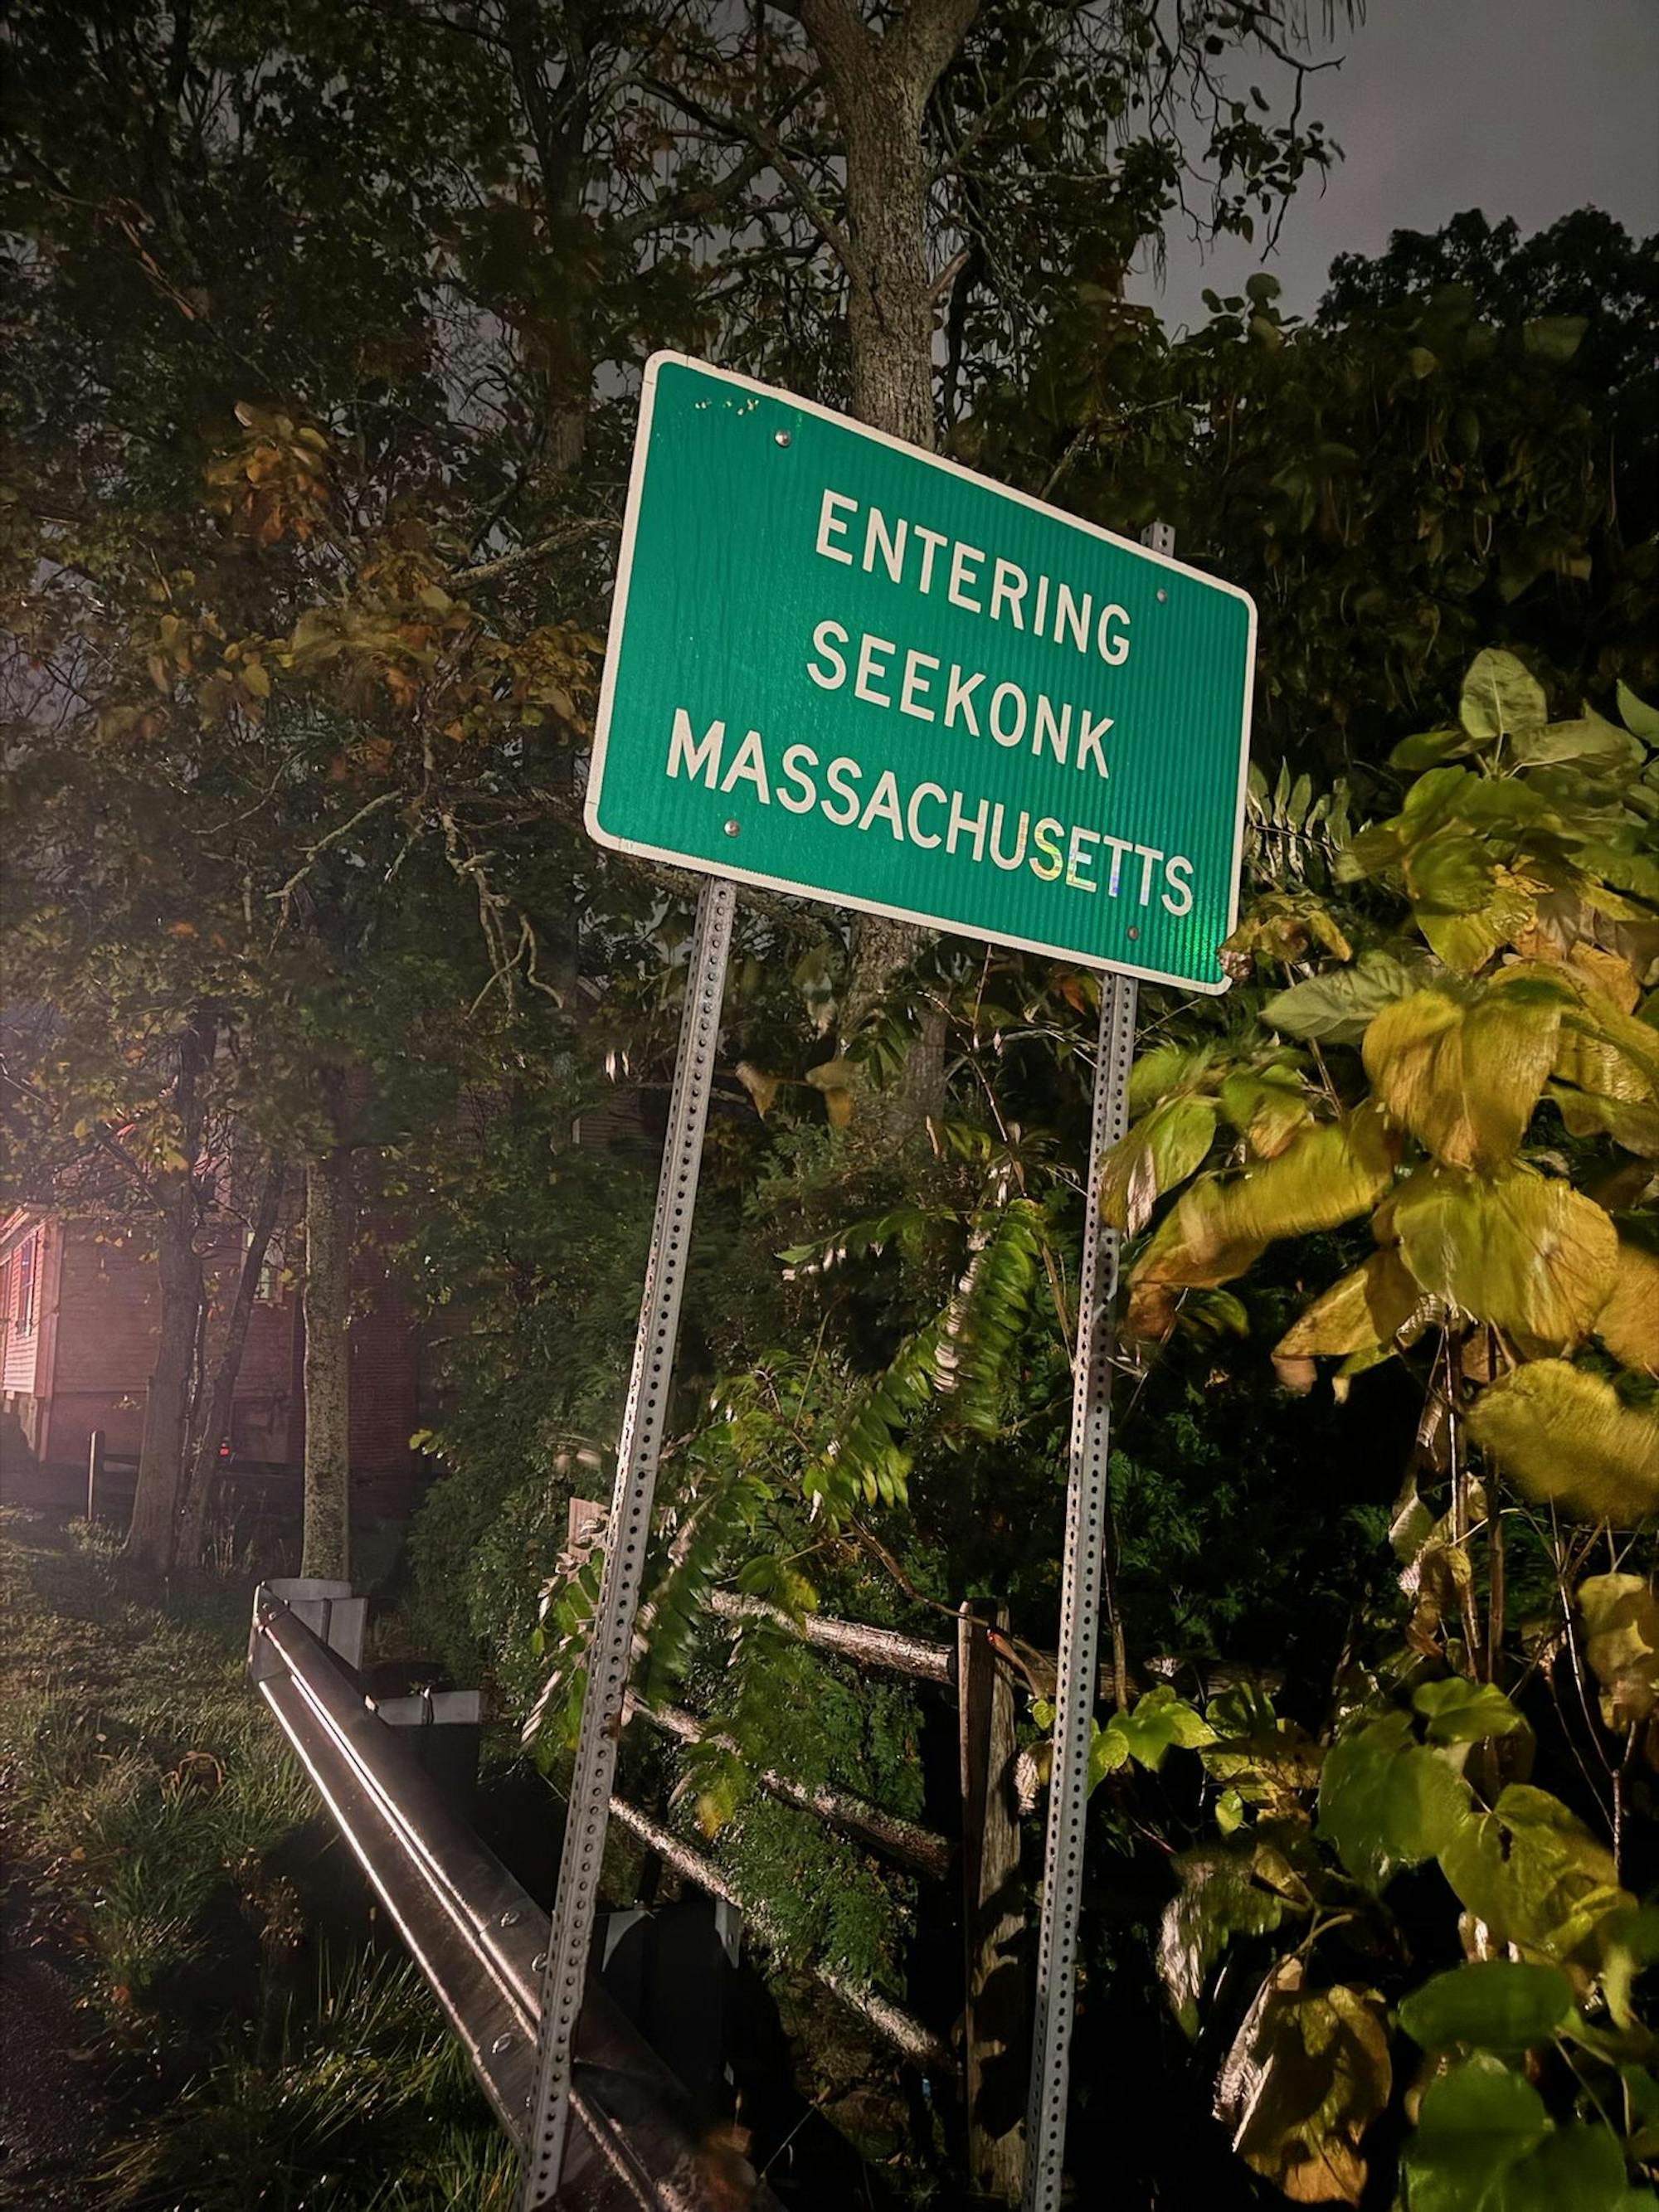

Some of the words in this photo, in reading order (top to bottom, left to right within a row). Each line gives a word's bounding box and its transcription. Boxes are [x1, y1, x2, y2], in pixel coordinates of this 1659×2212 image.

[816, 489, 1131, 665] ENTERING
[806, 620, 1114, 778] SEEKONK
[666, 708, 1194, 916] MASSACHUSETTS
